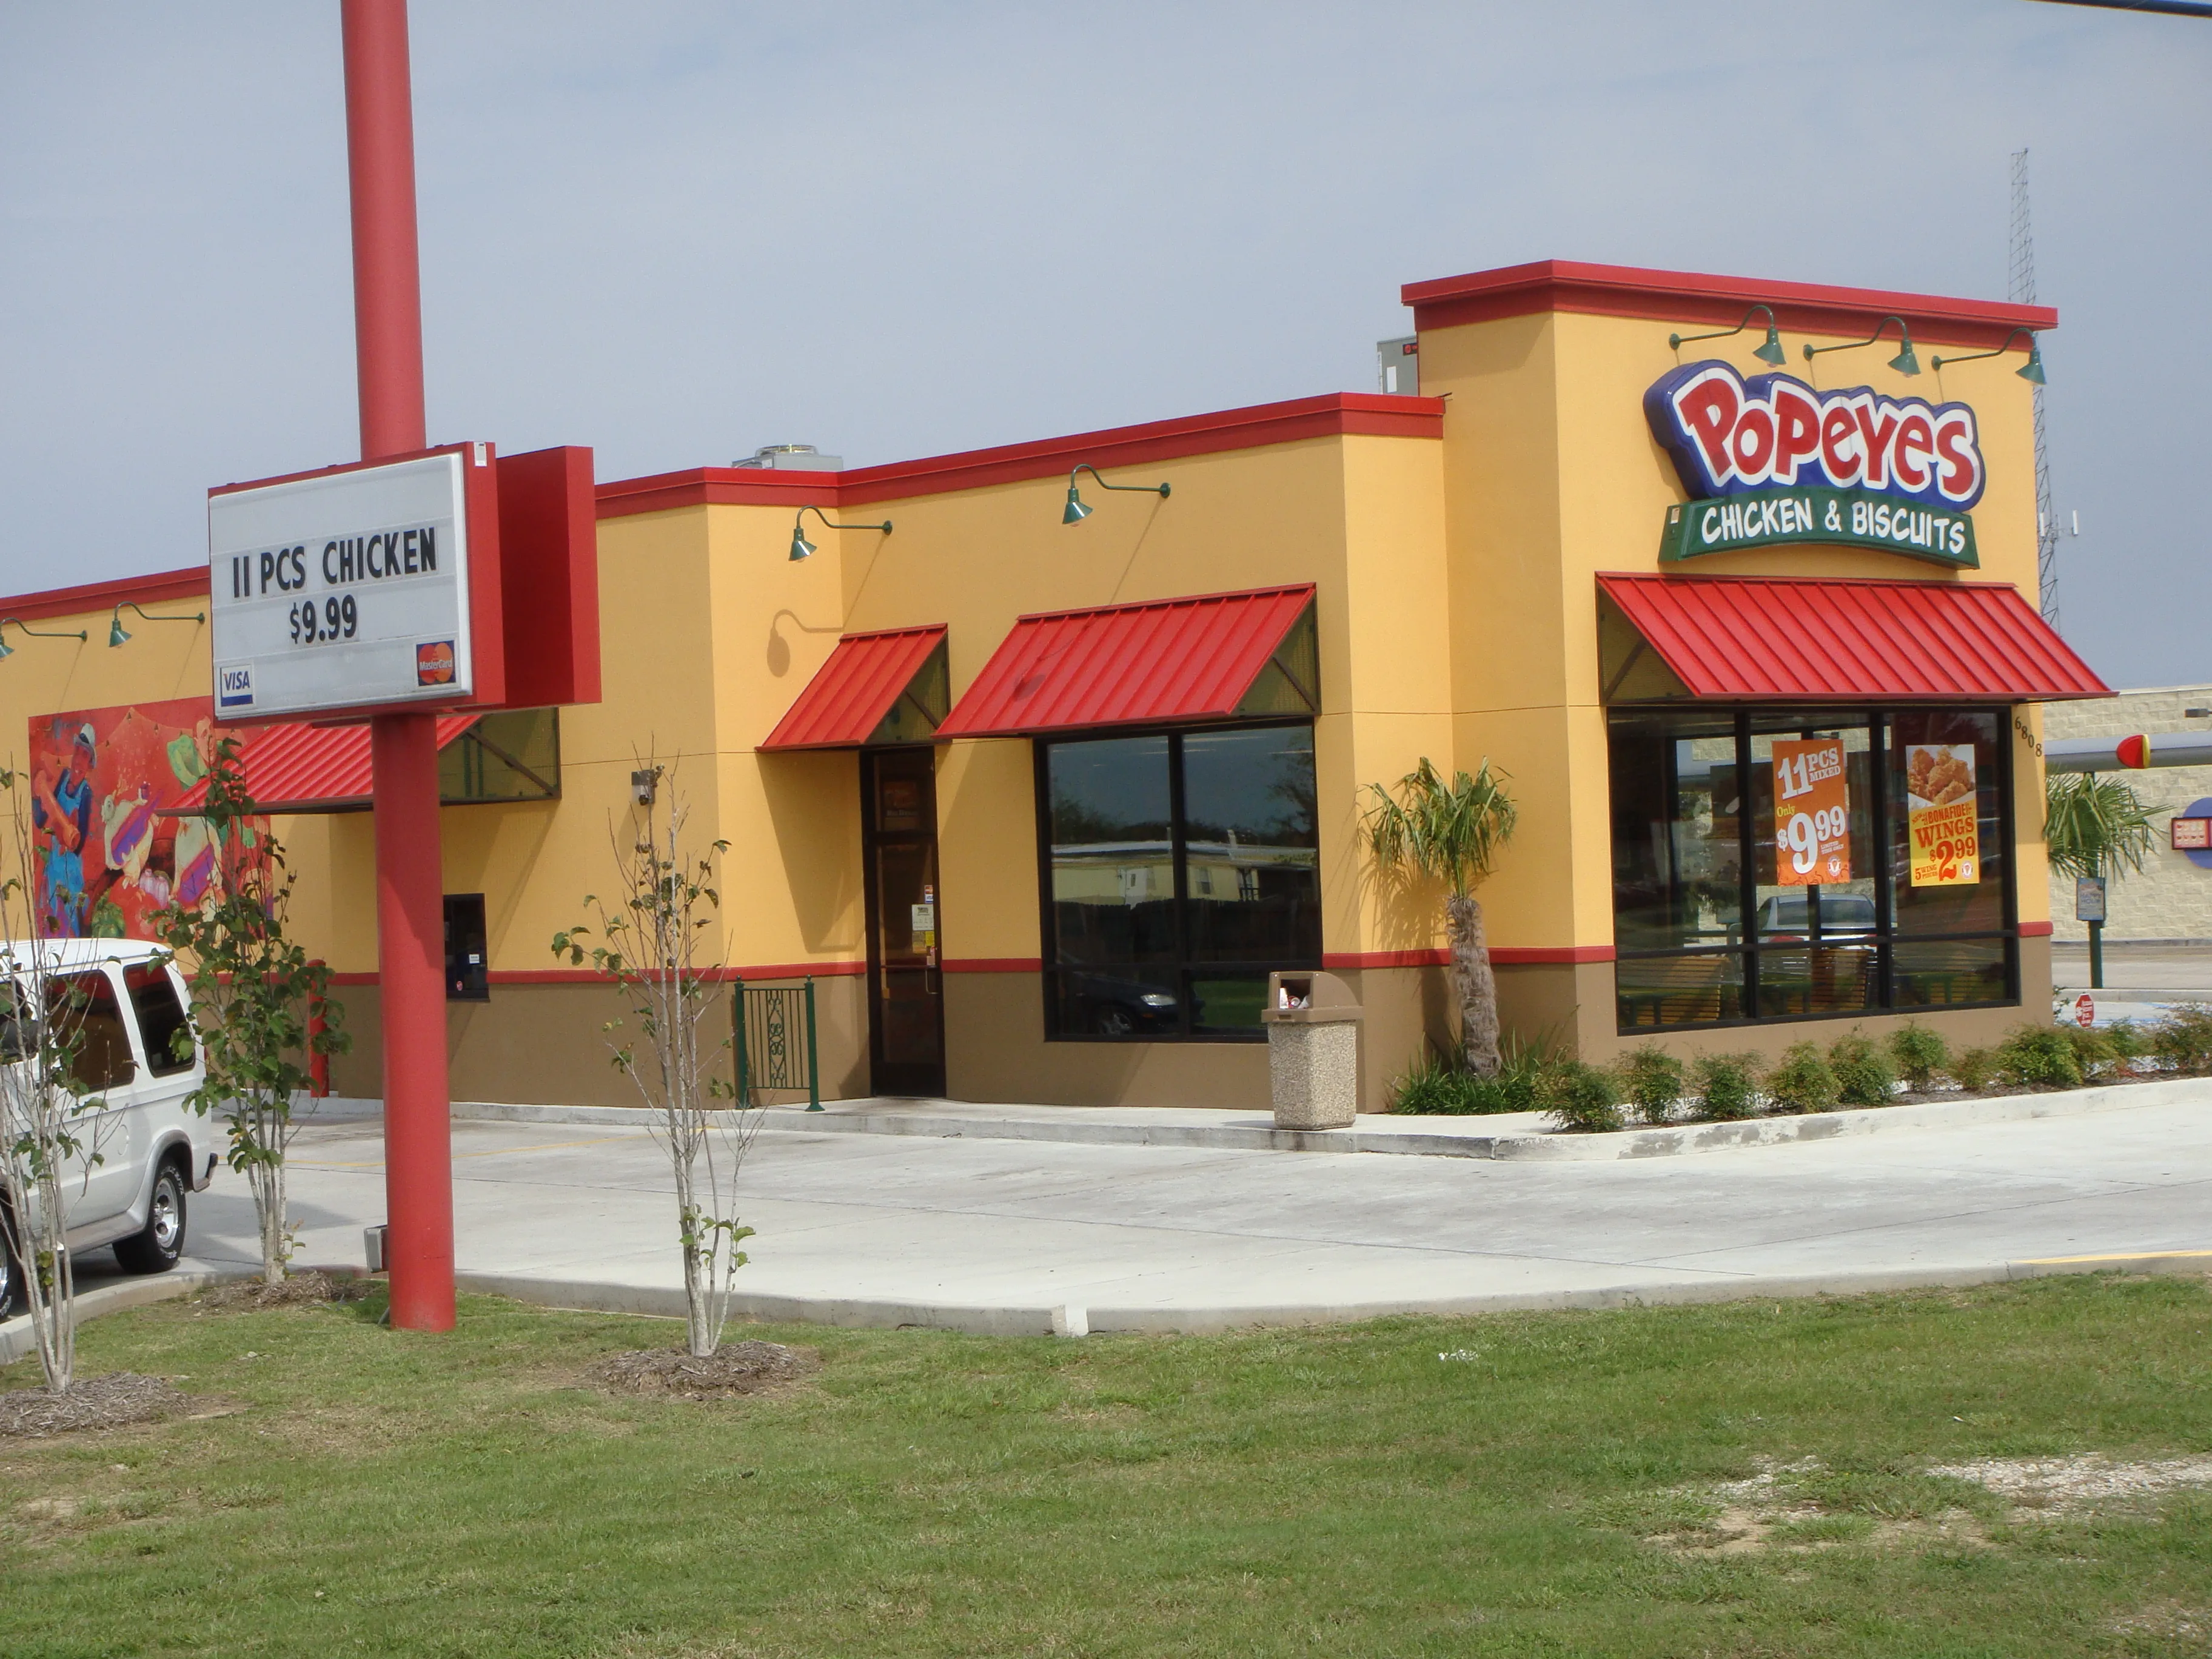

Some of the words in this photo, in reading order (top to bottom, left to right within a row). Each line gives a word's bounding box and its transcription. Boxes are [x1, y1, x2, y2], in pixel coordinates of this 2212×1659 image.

[1701, 497, 1813, 544] CHICKEN
[1825, 500, 1842, 533] &
[1852, 501, 1965, 554] BISCUITS
[260, 546, 306, 594] PCS
[322, 526, 437, 585] CHICKEN
[289, 594, 358, 644] $9.99
[418, 657, 454, 671] MasterCard
[223, 670, 250, 691] VISA
[2014, 716, 2042, 757] 6808
[1778, 752, 1814, 800] 11
[1806, 746, 1839, 772] PCS
[1809, 765, 1841, 782] MIXED
[1777, 804, 1795, 817] Only
[1914, 816, 1974, 848] WINGS
[1915, 867, 1922, 880] 5
[1921, 864, 1937, 873] WING
